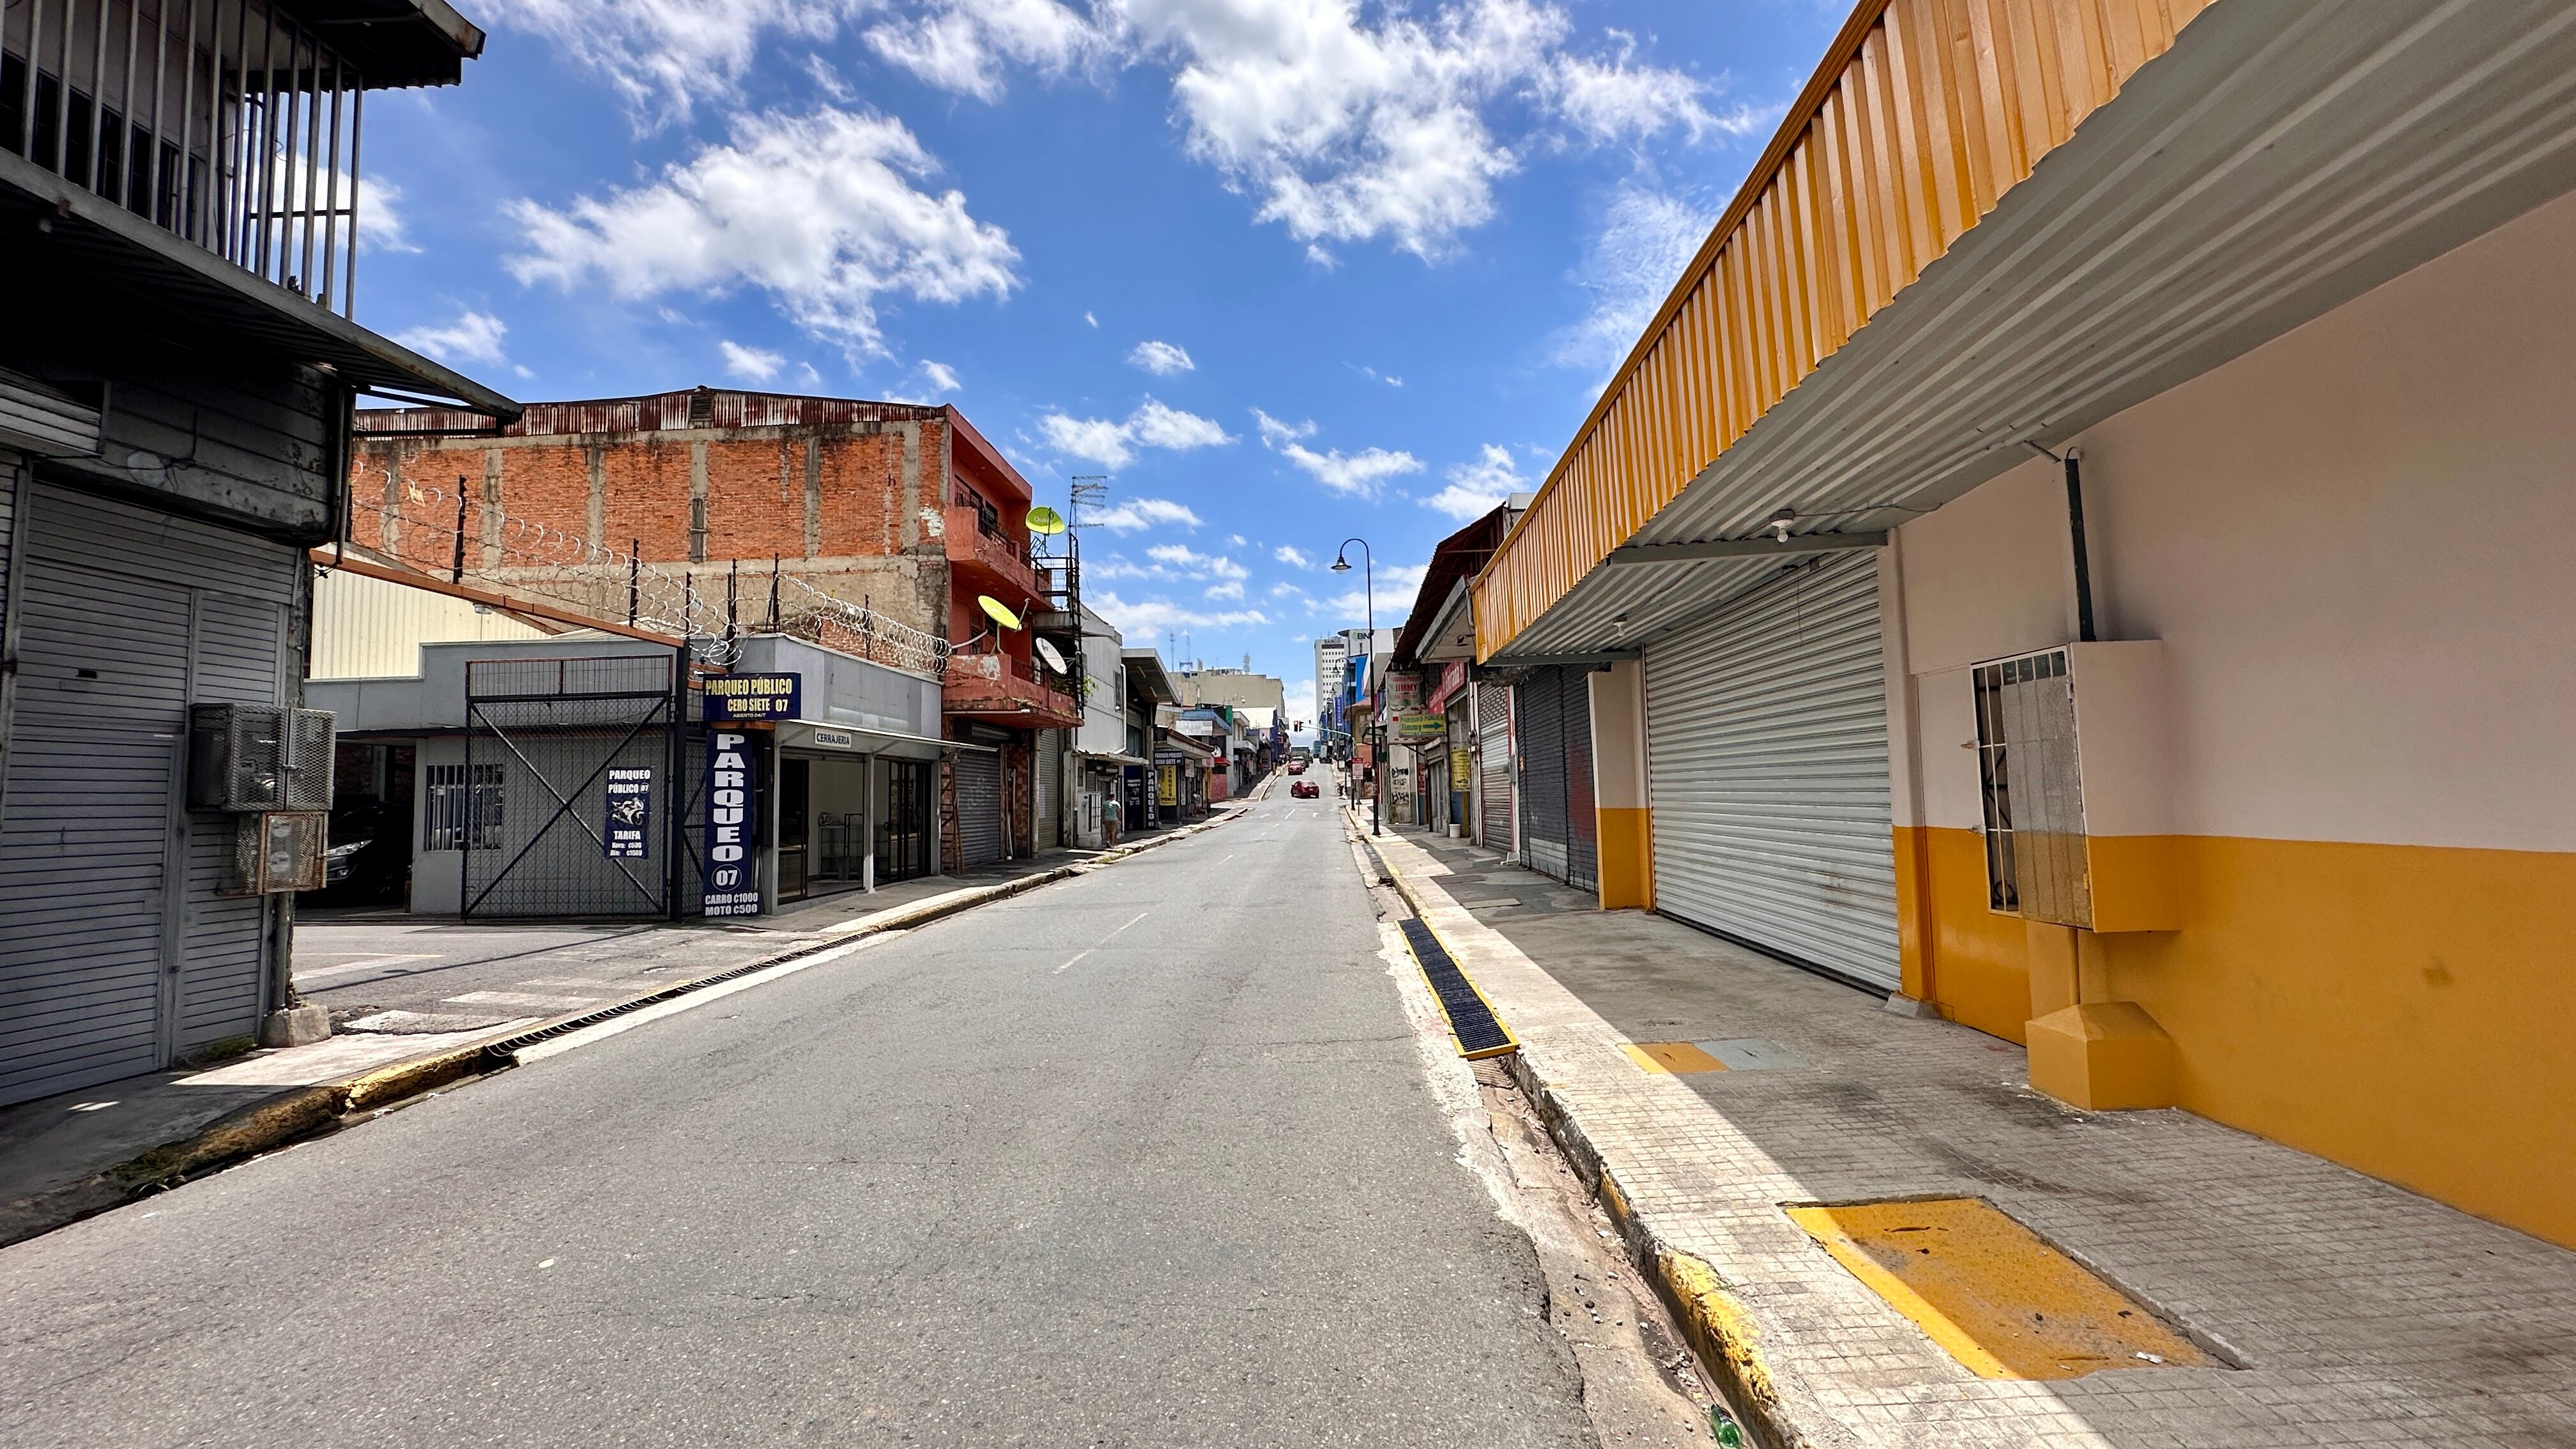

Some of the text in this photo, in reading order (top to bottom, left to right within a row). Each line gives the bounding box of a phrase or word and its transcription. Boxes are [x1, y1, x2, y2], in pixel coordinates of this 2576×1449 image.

[705, 677, 792, 697] PARQUEO PÚBLICO
[1395, 684, 1418, 692] JIMMY
[727, 698, 788, 712] CERO SIETE 07
[816, 733, 850, 744] CERRAJERIA
[609, 770, 651, 780] PARQUEO
[608, 783, 639, 793] PÚBLICO
[712, 734, 746, 862] PARQUEO
[613, 831, 641, 840] TARIFA
[716, 870, 738, 886] 07
[705, 894, 732, 905] CARRO
[705, 905, 732, 916] MOTO
